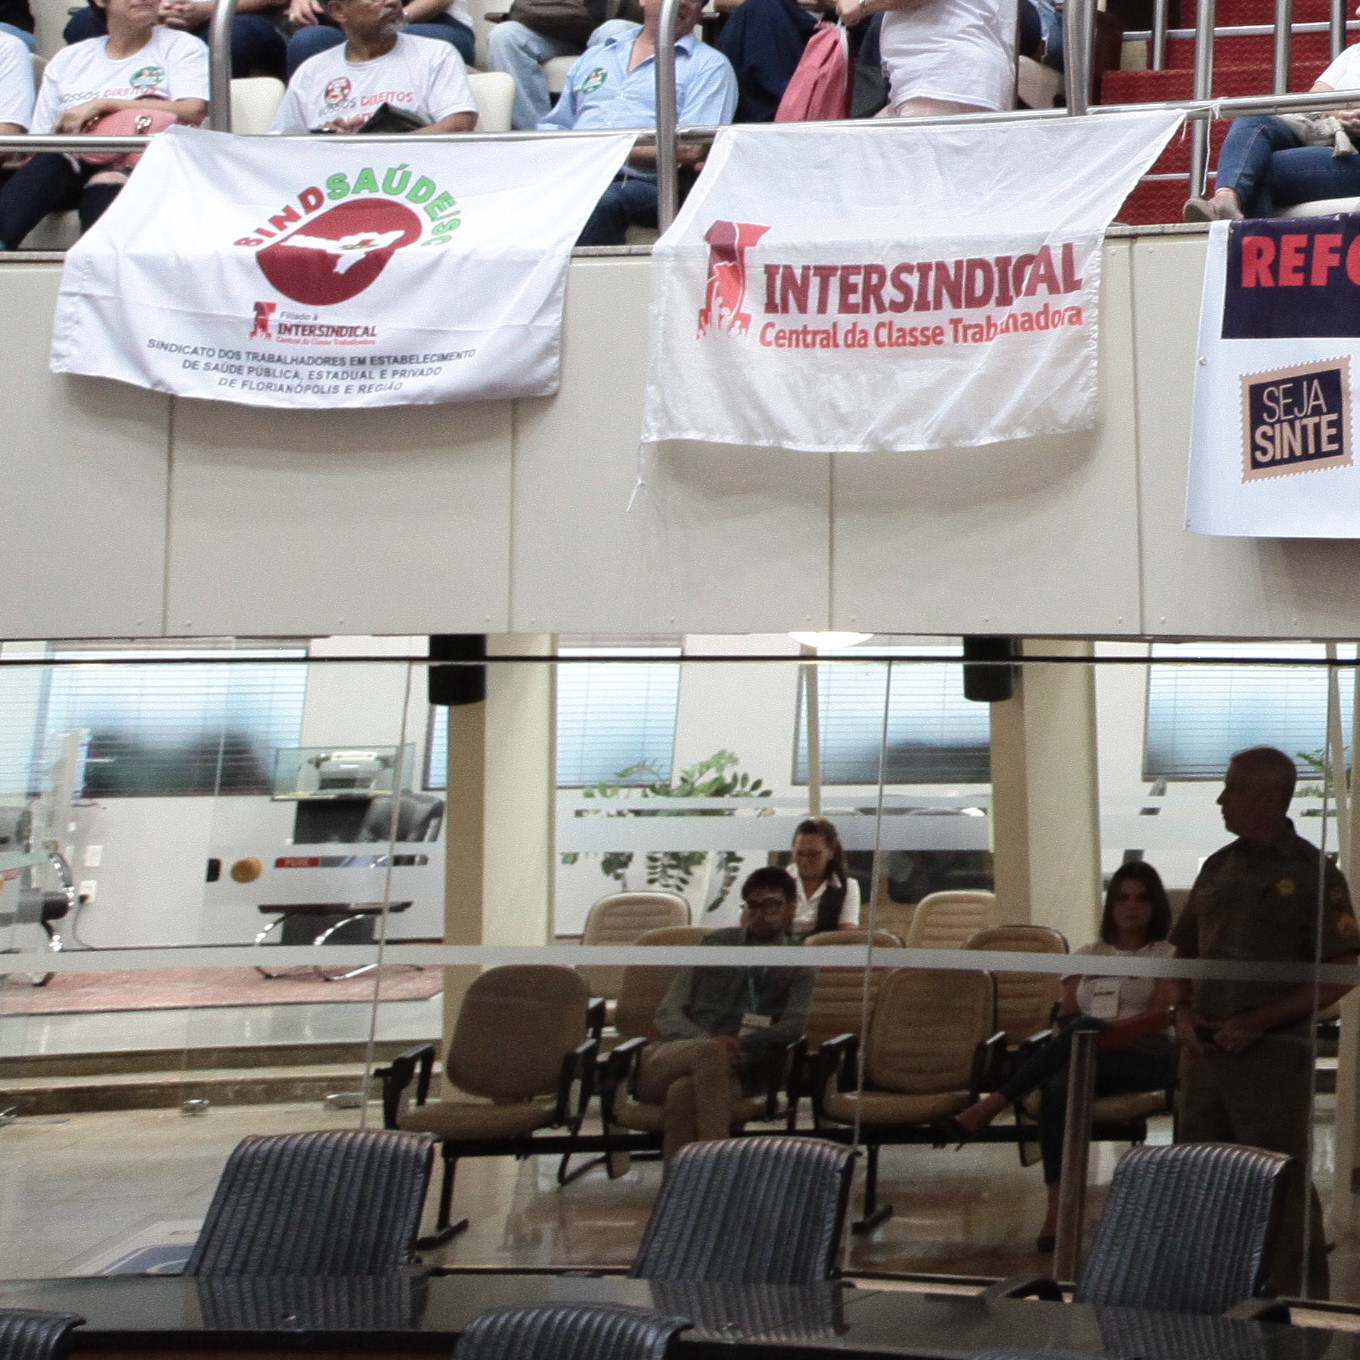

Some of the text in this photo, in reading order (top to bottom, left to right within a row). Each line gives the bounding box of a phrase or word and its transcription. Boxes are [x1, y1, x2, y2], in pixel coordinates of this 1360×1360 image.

[763, 242, 1085, 315] INTERSINDICAL
[278, 324, 377, 337] INTERSINDICAL
[759, 321, 840, 348] Central
[844, 321, 868, 349] da
[874, 321, 945, 347] Classe
[147, 339, 477, 366] SINDICATO DOS TRABALHADORES EM ESTABELECIMENTO
[182, 359, 200, 370] DE
[202, 361, 244, 375] SAÚDE
[308, 369, 375, 380] ESTADUAL
[379, 369, 387, 379] E
[391, 366, 443, 378] PRIVADO
[218, 377, 238, 389] DE
[241, 379, 340, 394] FLORIANÓPOLIS
[344, 384, 354, 394] E
[1262, 379, 1327, 423] SEJA
[1254, 413, 1340, 463] SINTE
